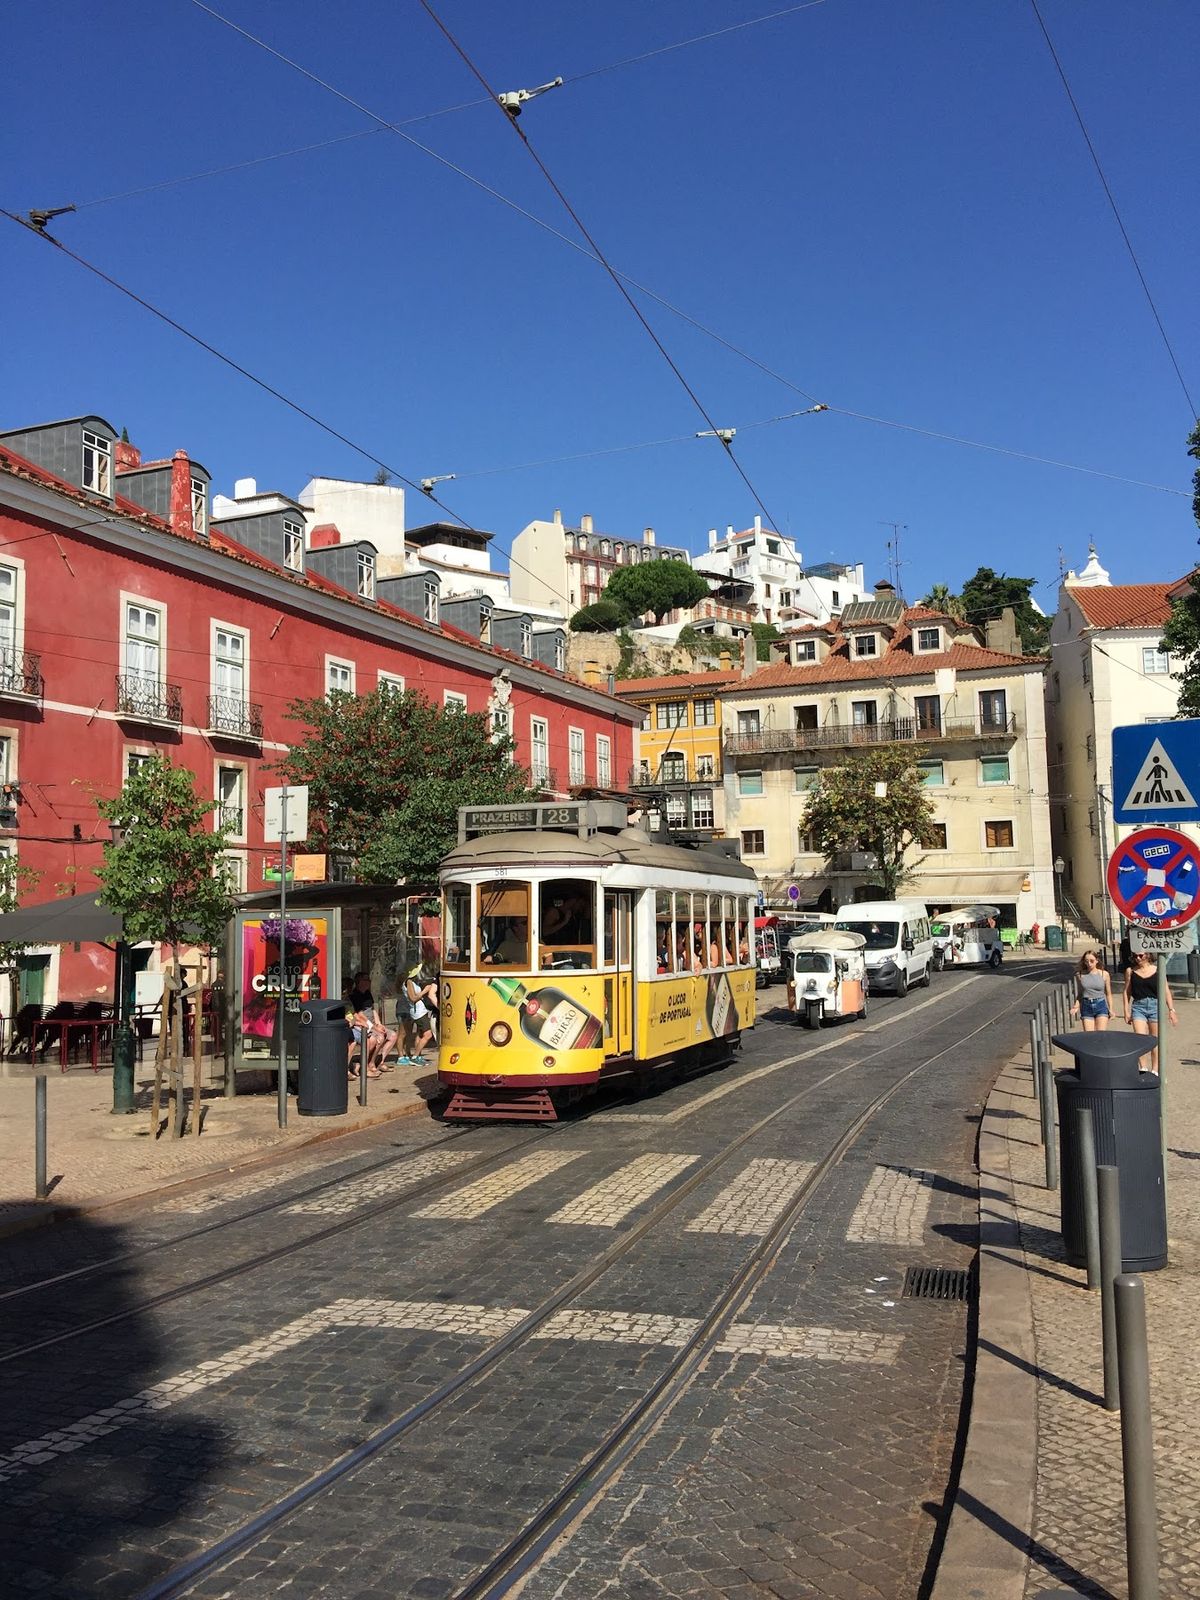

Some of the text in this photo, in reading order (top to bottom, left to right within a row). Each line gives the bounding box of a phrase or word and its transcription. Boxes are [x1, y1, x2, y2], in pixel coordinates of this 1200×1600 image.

[472, 811, 533, 824] PRAZERES
[547, 809, 570, 824] 28
[495, 867, 508, 877] 581
[1137, 930, 1184, 939] EXCEPTO
[1141, 940, 1181, 949] CARRIS
[267, 966, 301, 975] PORTO
[251, 974, 310, 992] CRUZ
[667, 993, 686, 1007] O LICOR
[659, 1006, 692, 1024] DE PORTUGAL
[550, 1009, 577, 1045] BEIRÃO
